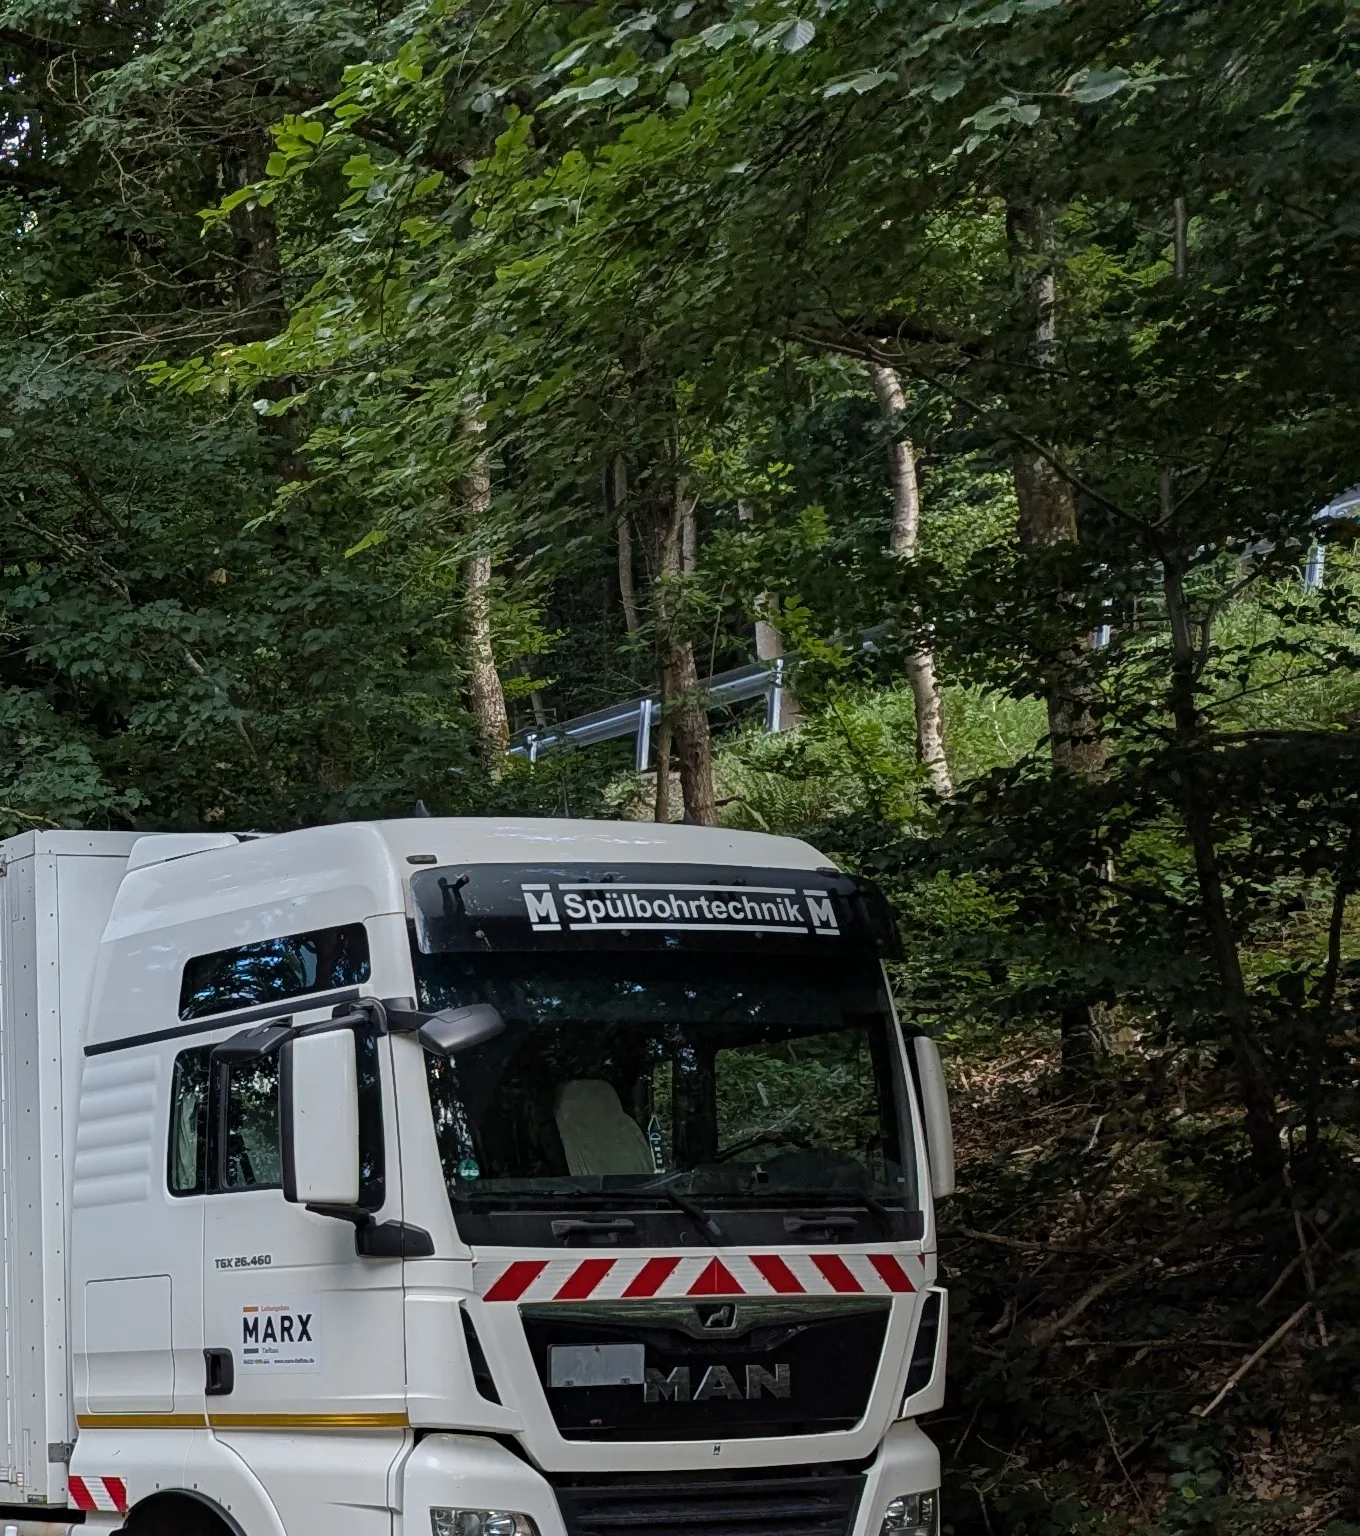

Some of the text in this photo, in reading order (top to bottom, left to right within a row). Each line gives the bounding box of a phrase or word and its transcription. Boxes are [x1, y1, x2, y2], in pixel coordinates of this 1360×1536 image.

[523, 892, 839, 927] M Spülbohrtechnik M
[215, 1258, 233, 1269] TGX
[242, 1313, 313, 1344] MARX
[644, 1363, 791, 1403] MAN
